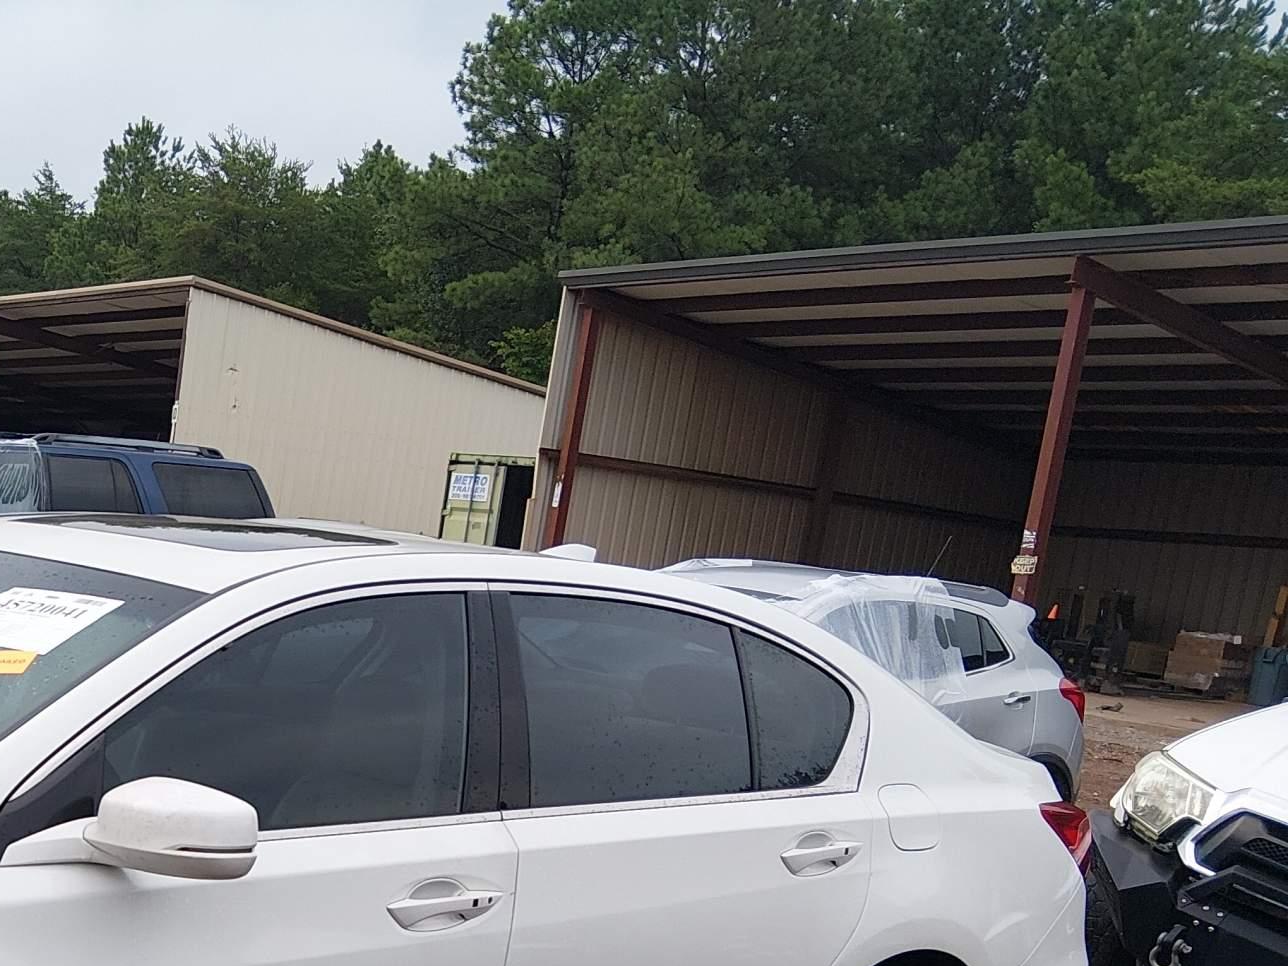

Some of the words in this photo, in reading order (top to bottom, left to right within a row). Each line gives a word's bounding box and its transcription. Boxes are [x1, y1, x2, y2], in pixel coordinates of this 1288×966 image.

[453, 474, 488, 486] METRO
[452, 485, 486, 494] TRAIER
[1015, 564, 1034, 572] OUT
